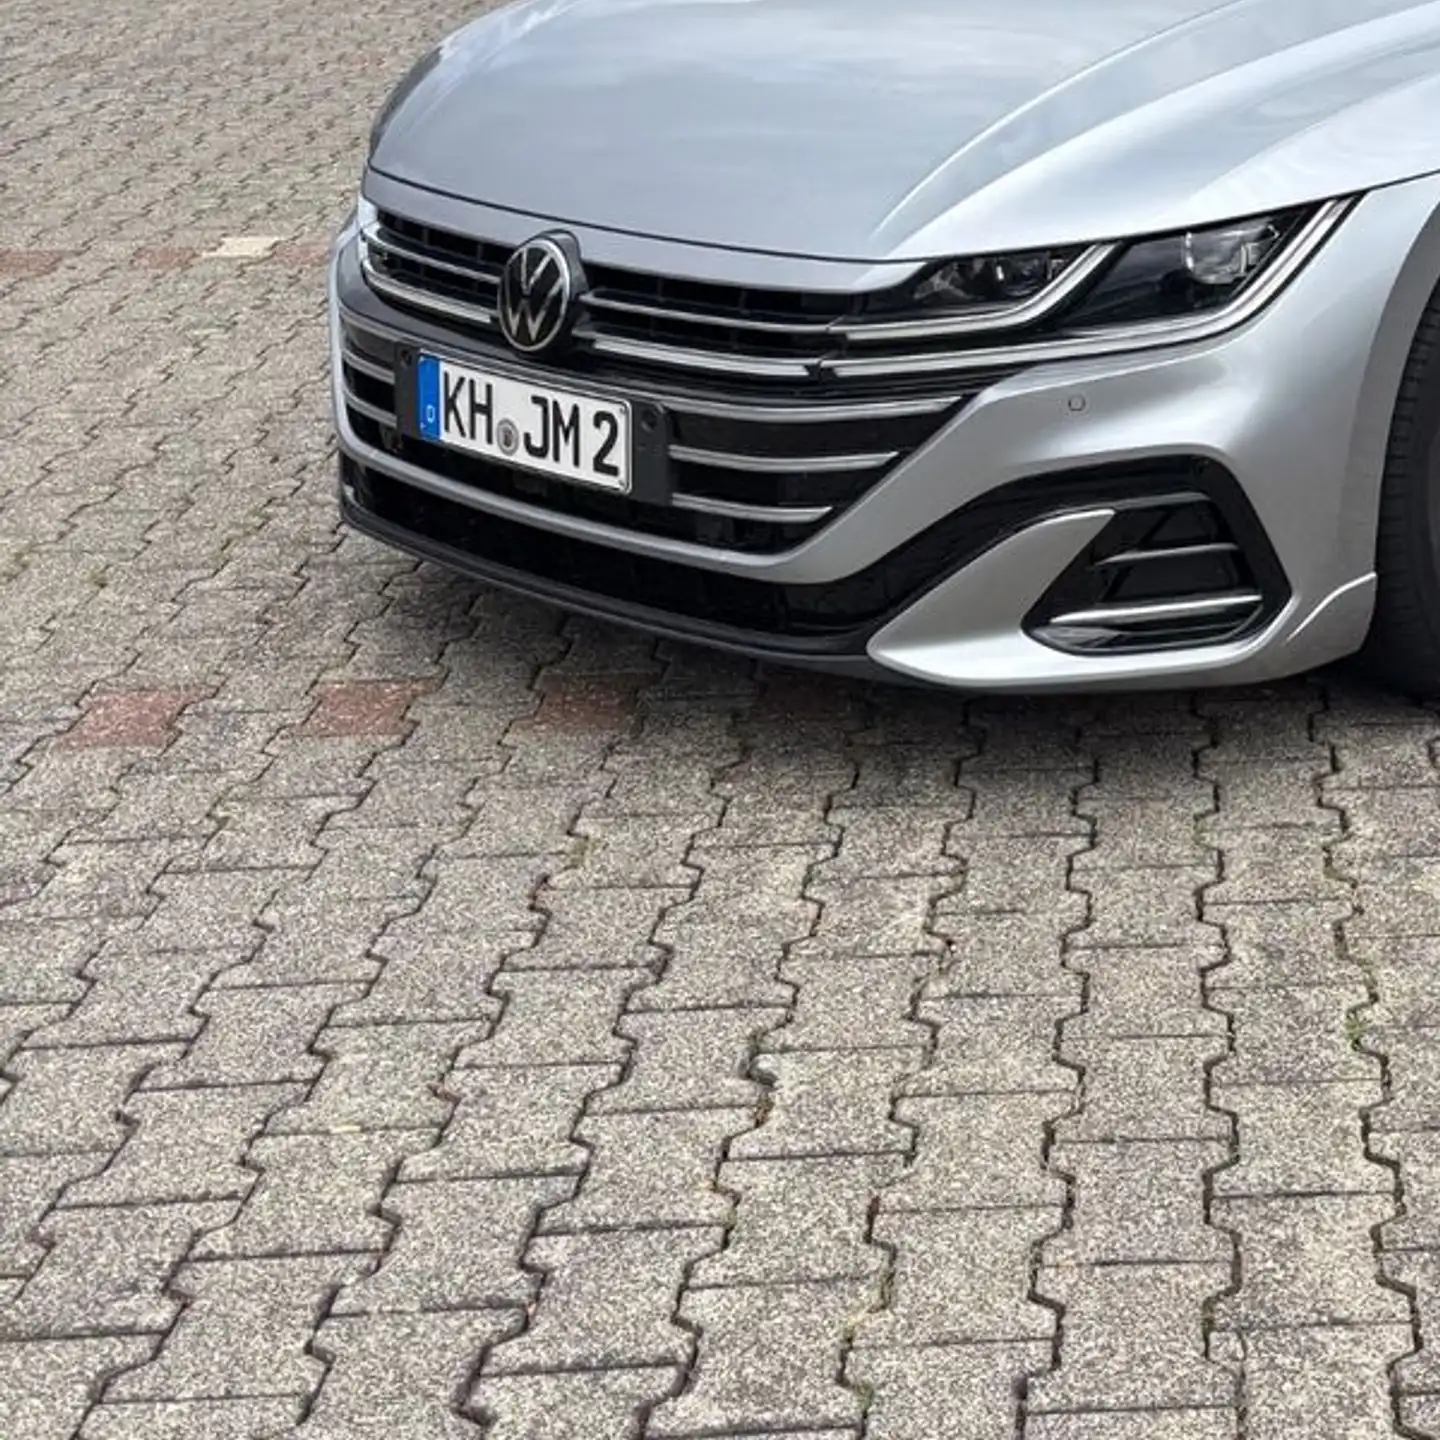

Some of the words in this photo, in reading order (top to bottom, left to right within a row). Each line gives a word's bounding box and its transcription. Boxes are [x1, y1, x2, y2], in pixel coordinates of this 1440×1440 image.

[443, 370, 493, 445] KH
[523, 395, 580, 468] JM
[592, 410, 619, 477] 2
